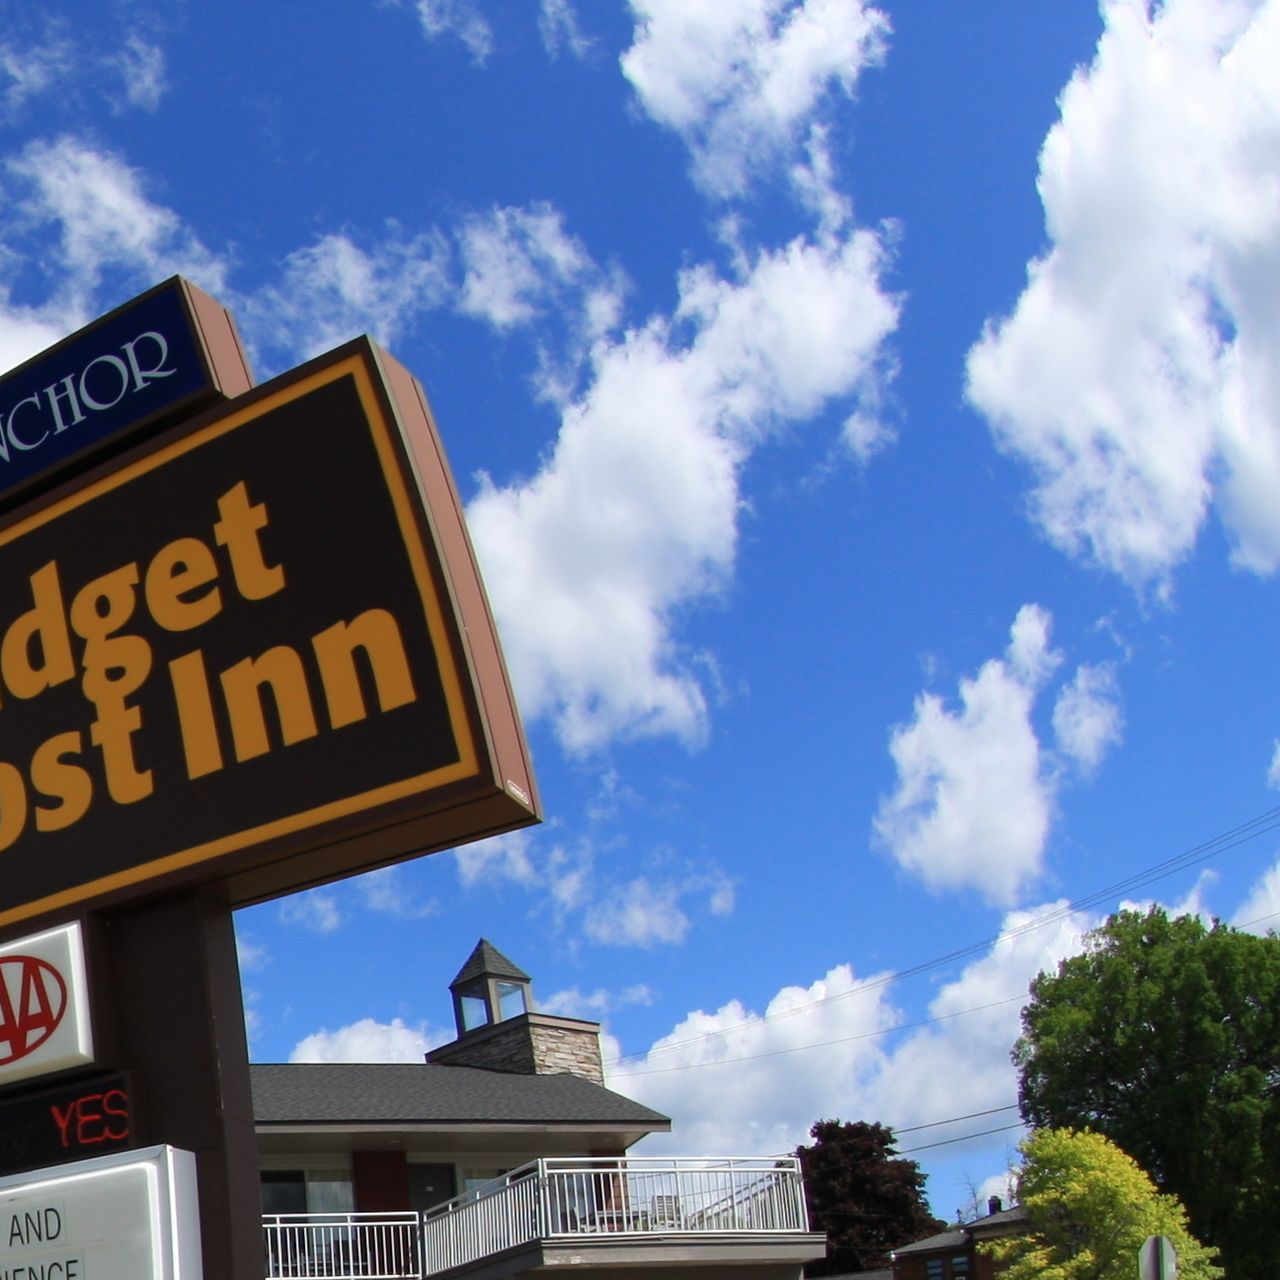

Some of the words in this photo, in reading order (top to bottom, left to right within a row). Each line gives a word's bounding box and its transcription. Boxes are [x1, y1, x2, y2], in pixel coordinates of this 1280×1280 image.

[169, 608, 417, 779] Inn
[51, 1089, 128, 1148] YES
[8, 1207, 62, 1248] AND
